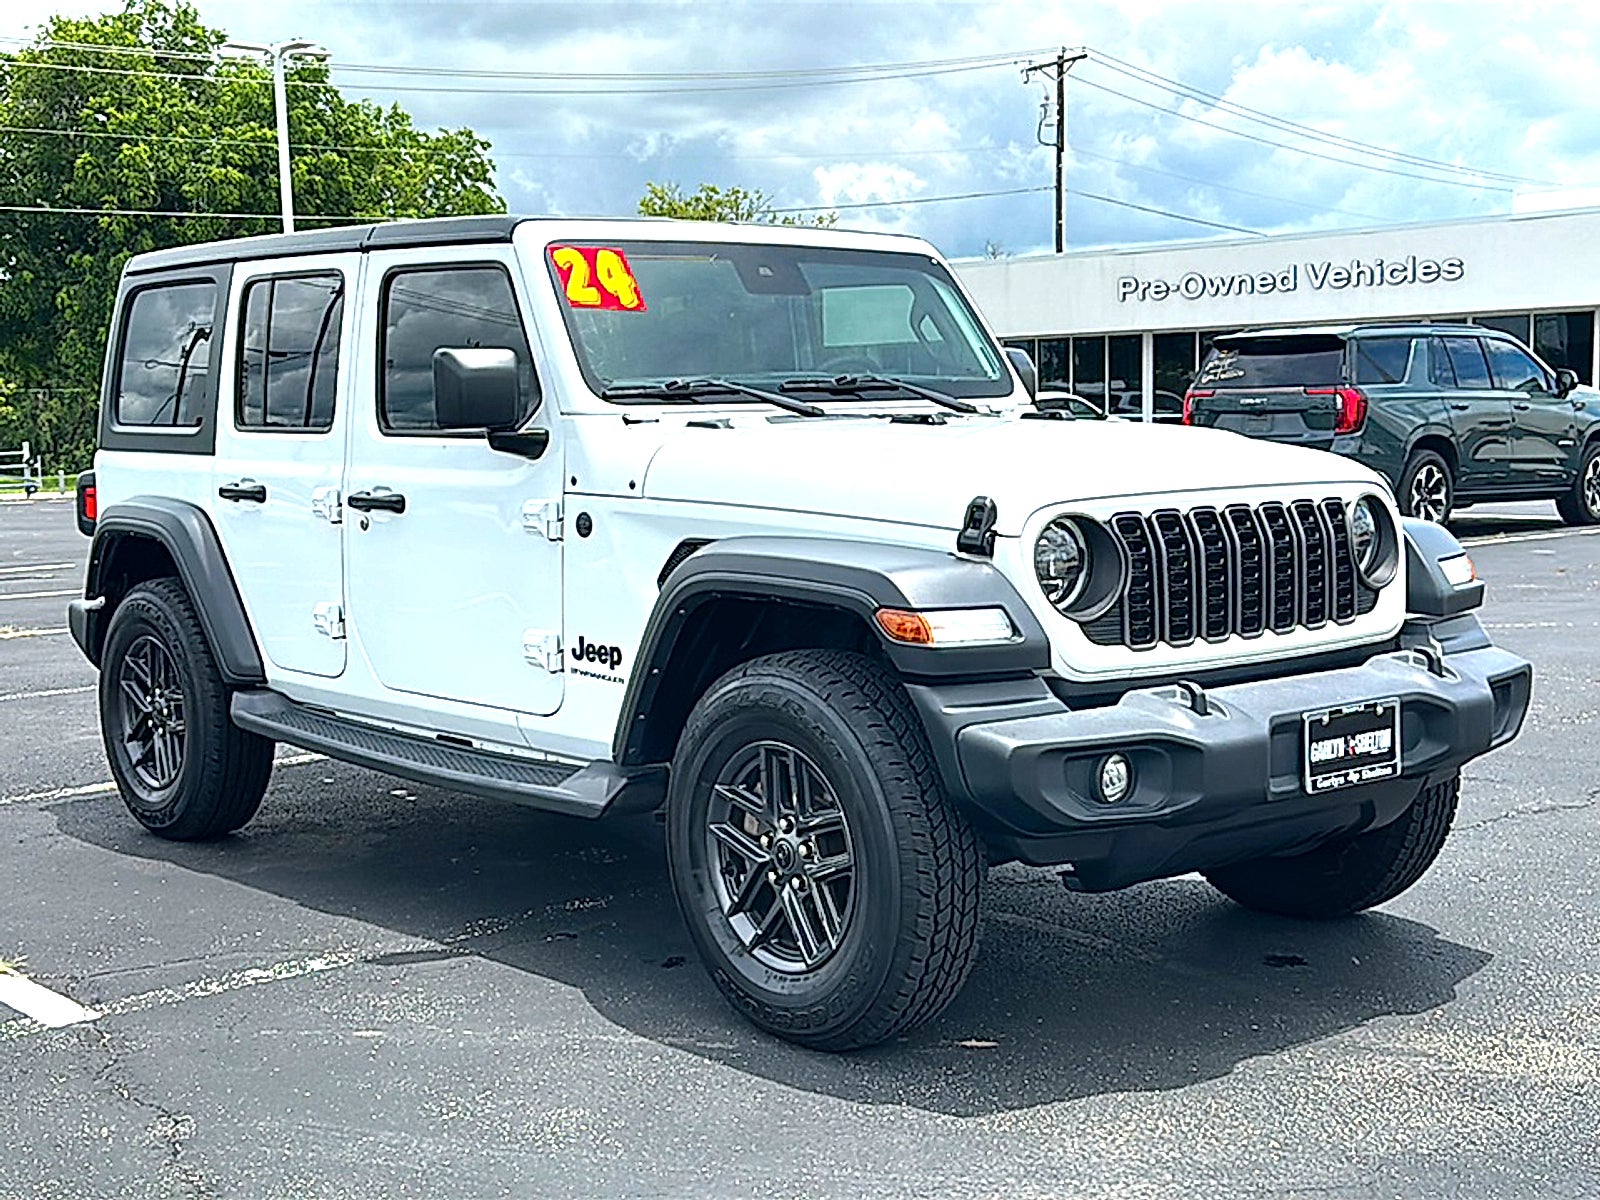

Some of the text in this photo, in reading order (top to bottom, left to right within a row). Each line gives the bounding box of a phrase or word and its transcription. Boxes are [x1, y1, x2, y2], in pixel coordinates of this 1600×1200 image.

[552, 246, 640, 309] 24
[1117, 254, 1466, 302] Pre-Owned Vehicles
[571, 635, 622, 670] Jeep
